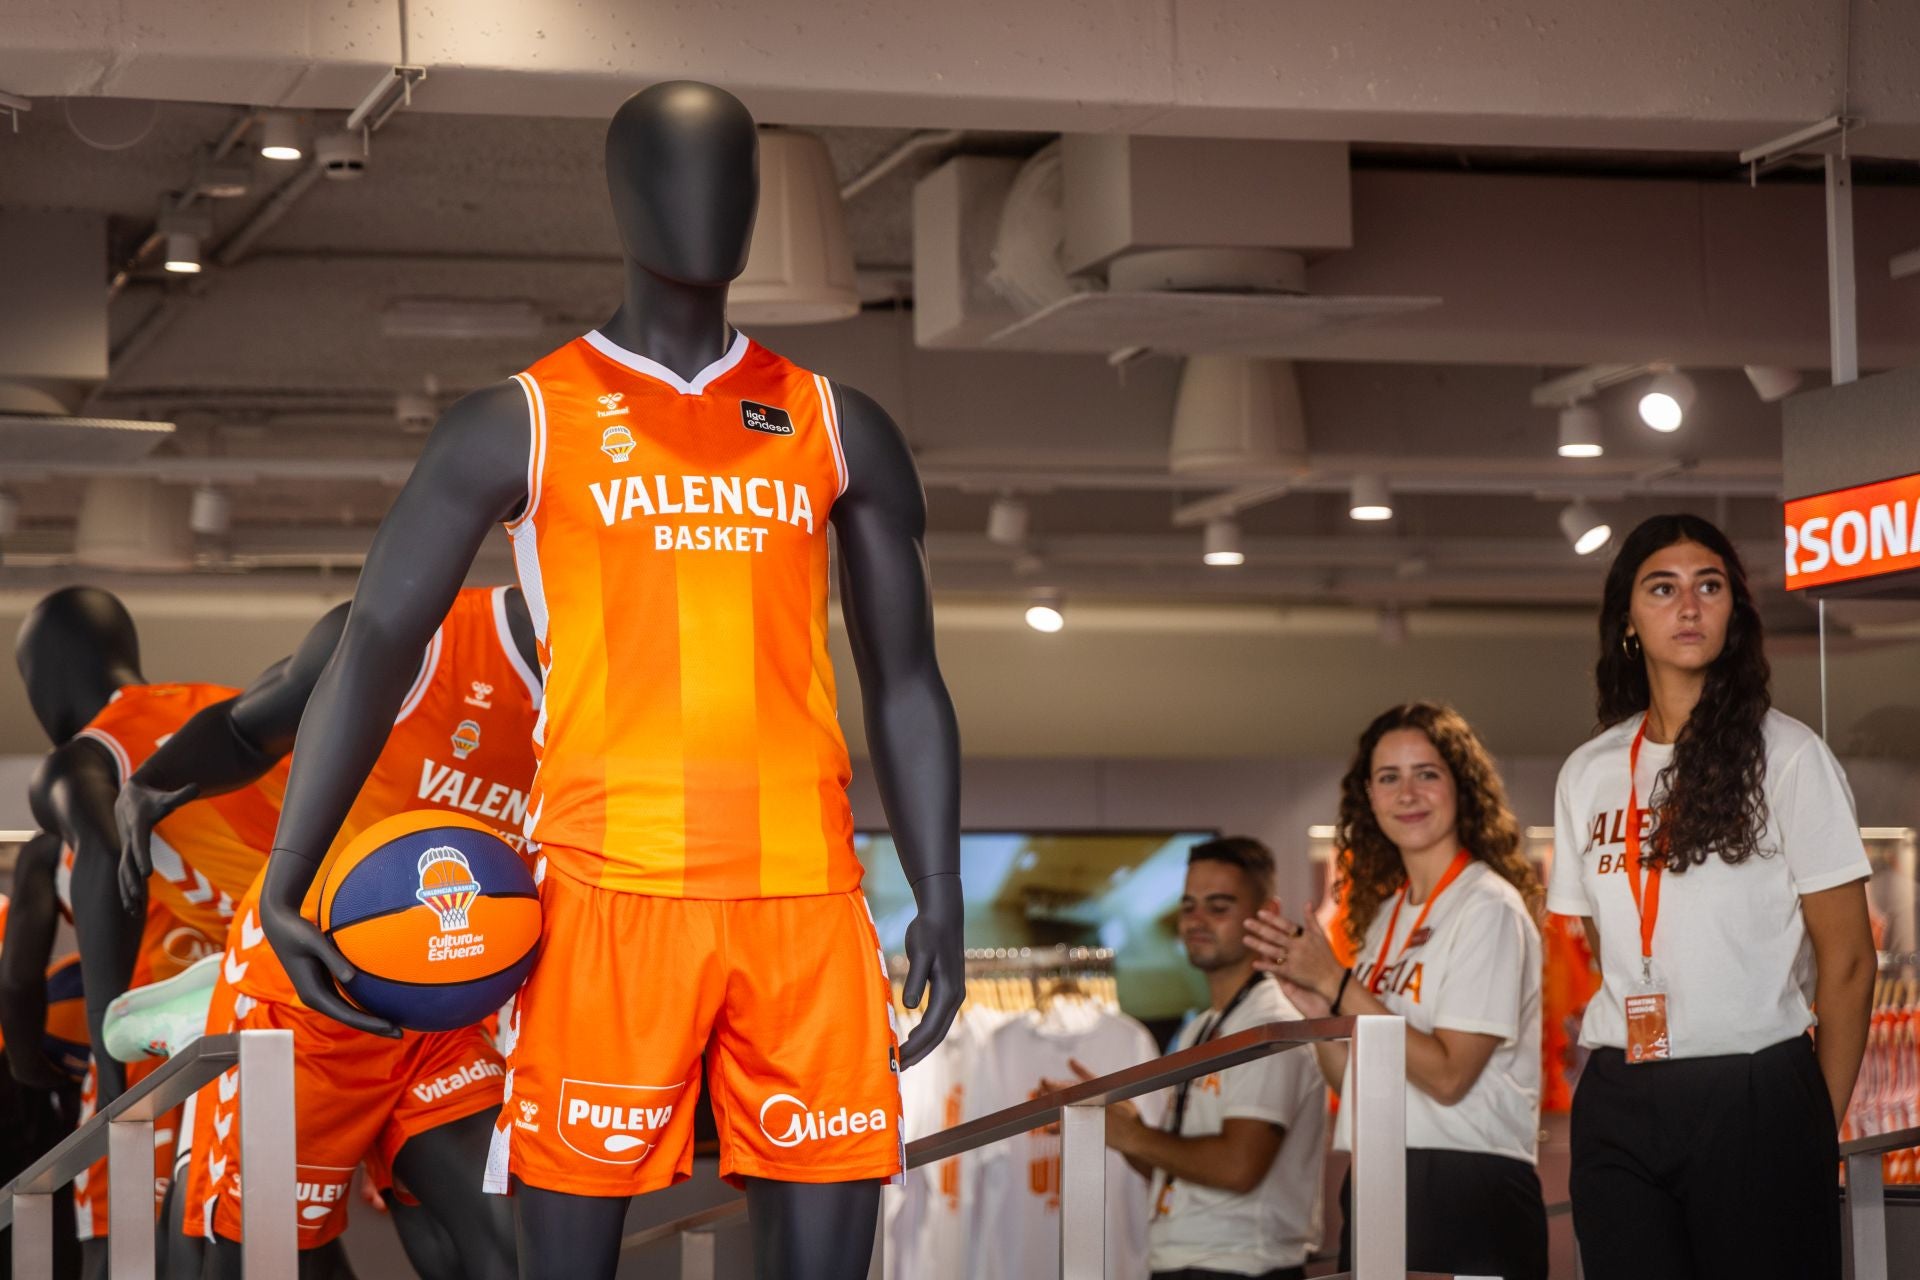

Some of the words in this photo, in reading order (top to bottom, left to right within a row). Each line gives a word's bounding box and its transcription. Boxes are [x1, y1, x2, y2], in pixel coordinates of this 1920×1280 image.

[746, 408, 766, 421] liga
[747, 419, 790, 433] endesa
[588, 474, 813, 535] VALENCIA
[654, 525, 769, 552] BASKET
[417, 758, 530, 825] VALEN
[428, 933, 473, 949] Cultura
[428, 943, 485, 961] Esfuerzo
[778, 1106, 887, 1142] Midea
